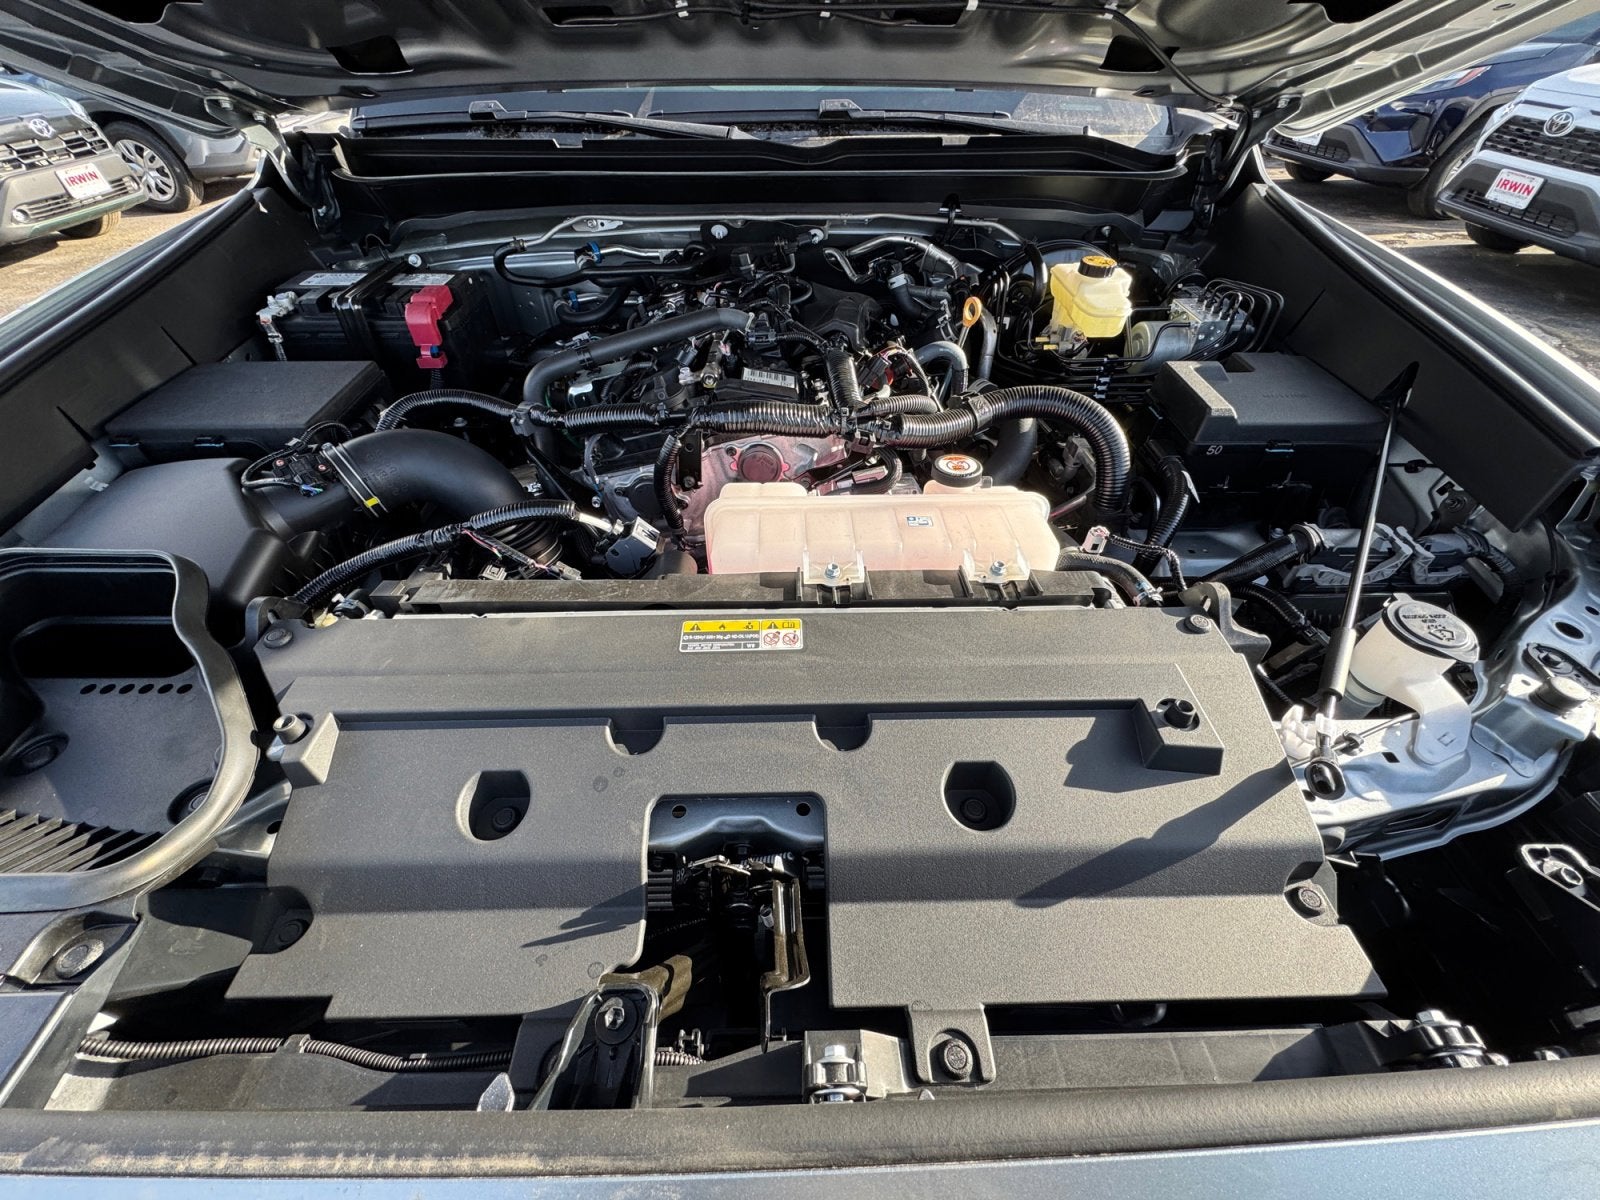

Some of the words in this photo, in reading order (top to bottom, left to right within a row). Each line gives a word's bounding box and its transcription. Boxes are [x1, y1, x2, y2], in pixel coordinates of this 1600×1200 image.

[65, 171, 99, 187] IRWIN
[1496, 177, 1535, 196] IRWIN
[1206, 445, 1223, 455] 50
